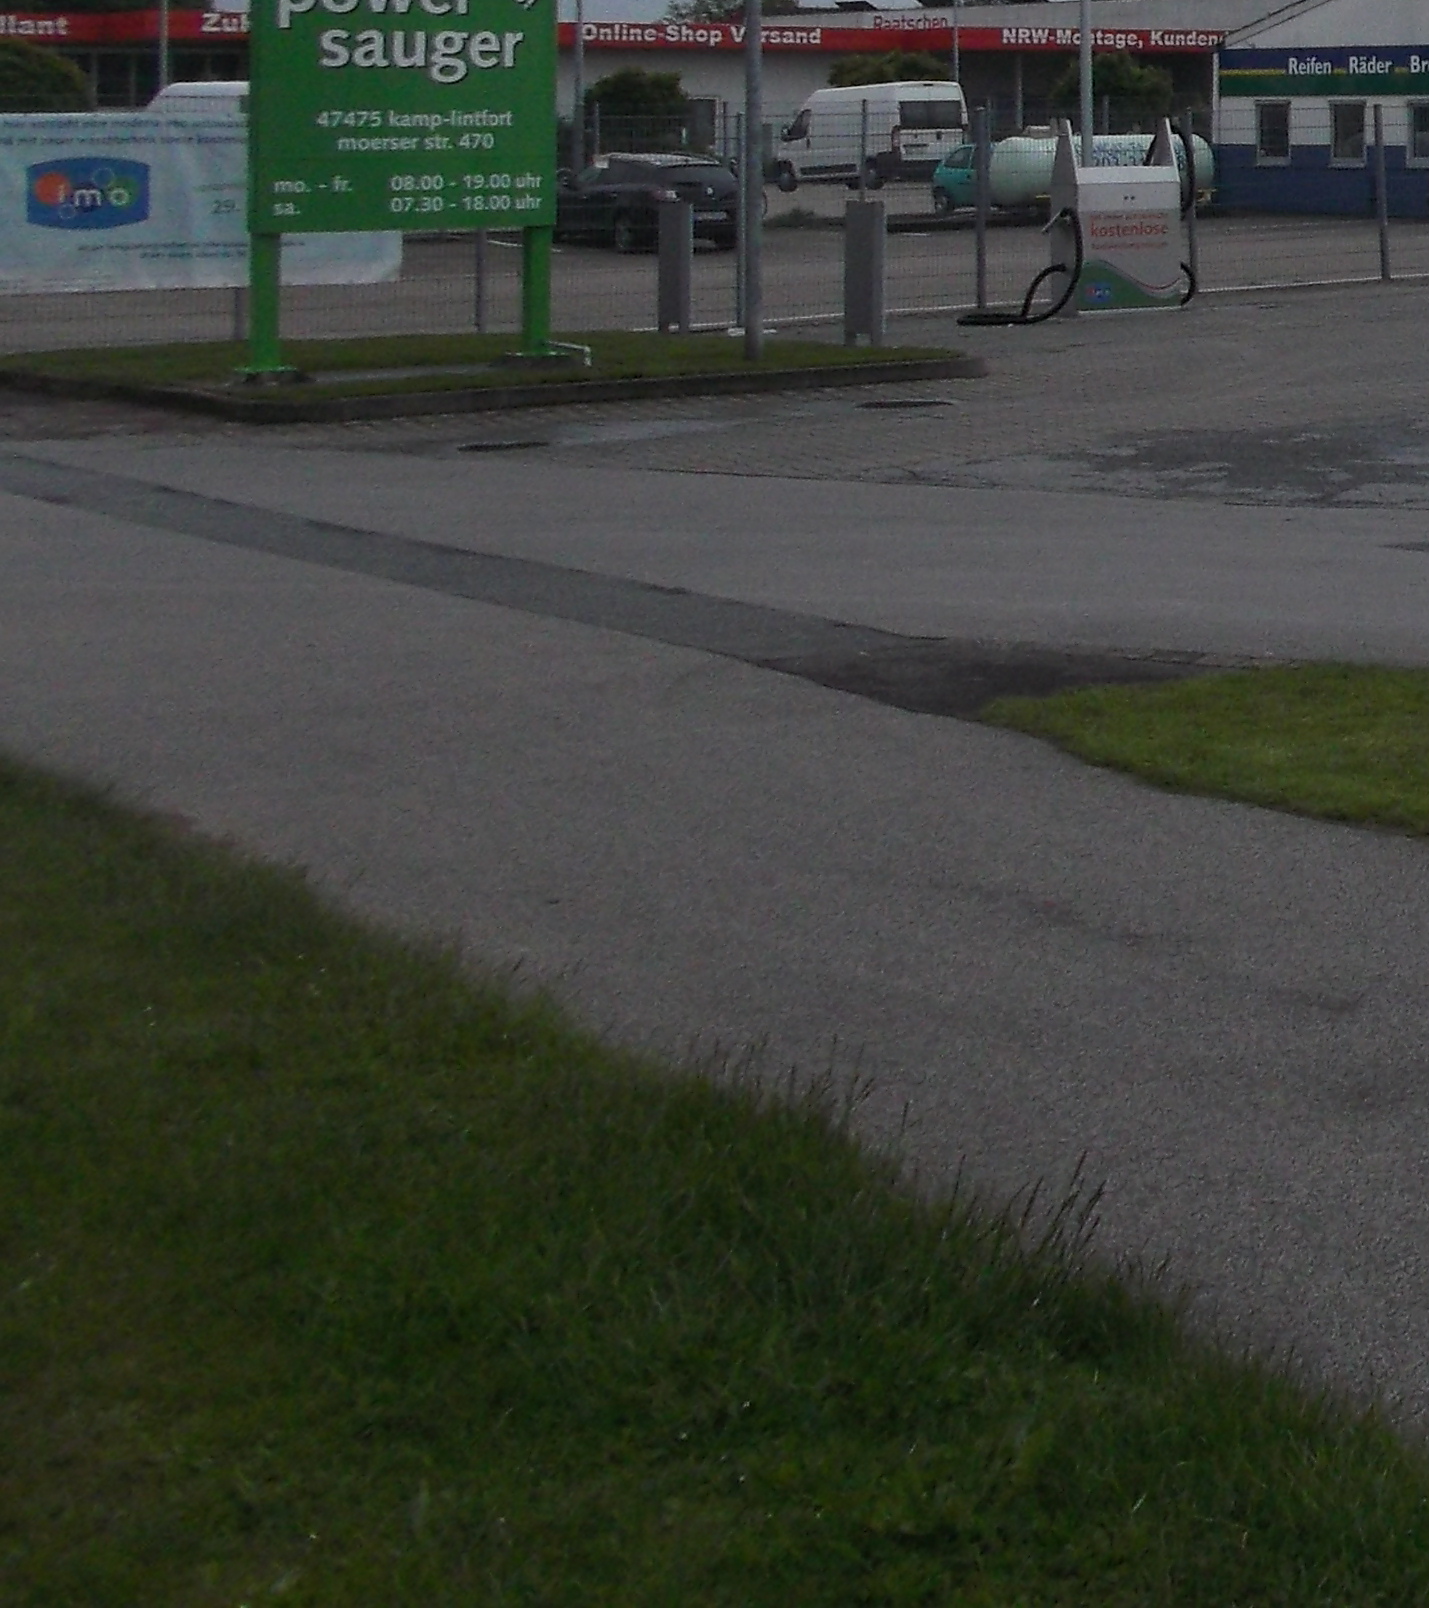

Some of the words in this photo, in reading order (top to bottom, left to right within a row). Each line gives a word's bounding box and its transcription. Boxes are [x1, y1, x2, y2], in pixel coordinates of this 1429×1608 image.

[581, 24, 722, 47] Online-Shop
[730, 25, 822, 45] Vrsand
[1001, 28, 1144, 49] NRW-Motage,
[319, 28, 525, 84] sauger
[1287, 57, 1333, 76] Reifen
[1347, 54, 1393, 74] Räder
[315, 110, 382, 128] 47475
[387, 109, 514, 131] kamp-lintfort
[337, 135, 418, 151] moerser
[424, 134, 453, 150] str.
[458, 132, 495, 150] 470
[273, 178, 312, 193] mo.
[331, 175, 353, 192] fr.
[390, 175, 444, 192] 08.00
[462, 174, 512, 190] 19.00
[515, 172, 543, 189] uhr
[57, 183, 130, 208] imo
[272, 201, 301, 216] sa.
[389, 196, 444, 213] 07.30
[462, 194, 512, 211] 18.00
[515, 193, 542, 210] uhr
